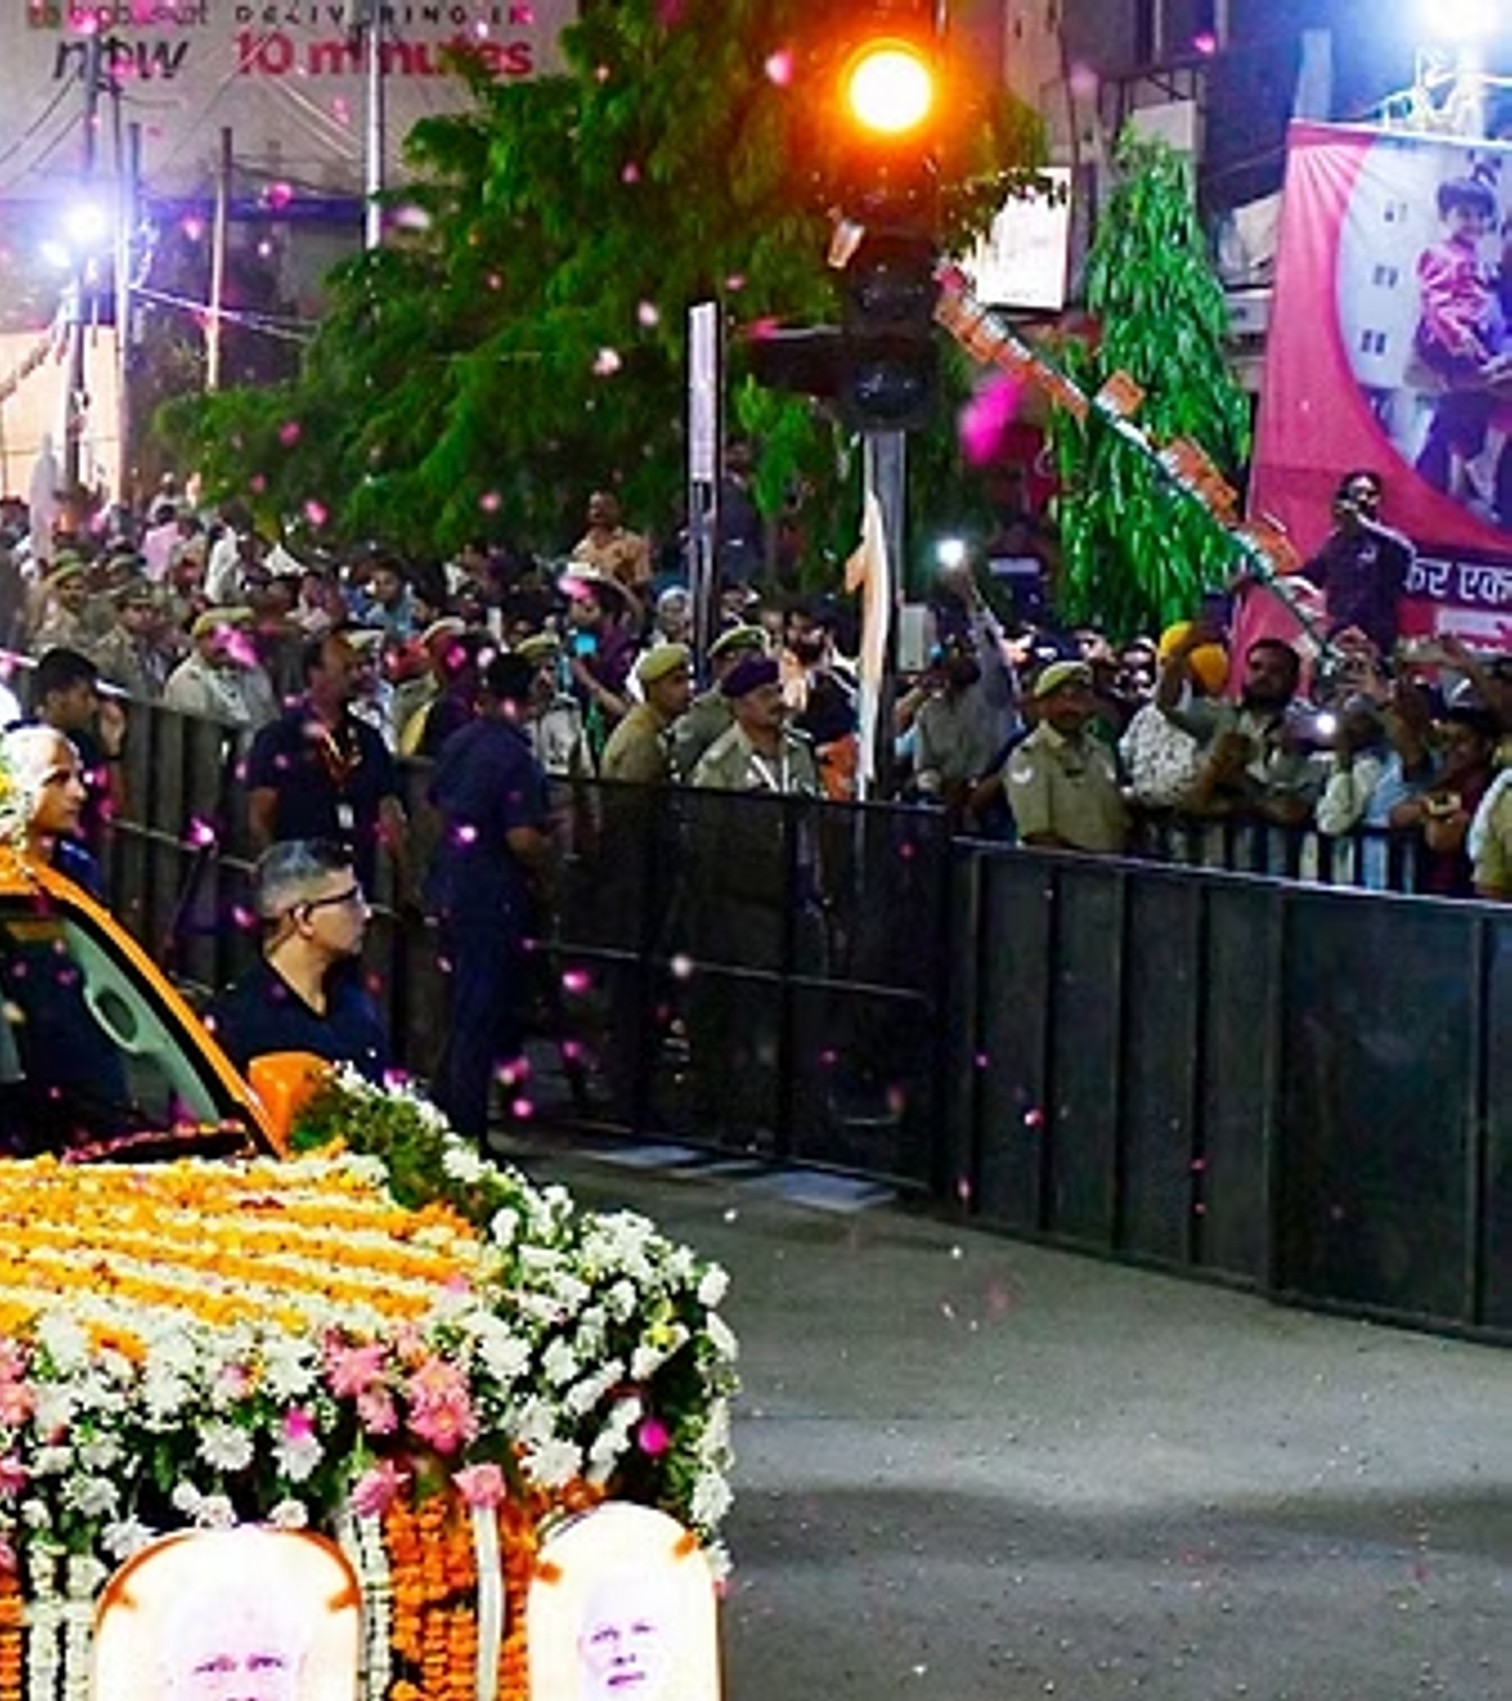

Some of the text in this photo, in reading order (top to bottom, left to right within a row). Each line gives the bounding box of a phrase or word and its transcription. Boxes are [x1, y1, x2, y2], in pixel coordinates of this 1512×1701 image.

[234, 5, 467, 25] DELIVRING
[235, 31, 533, 76] 10 mnues
